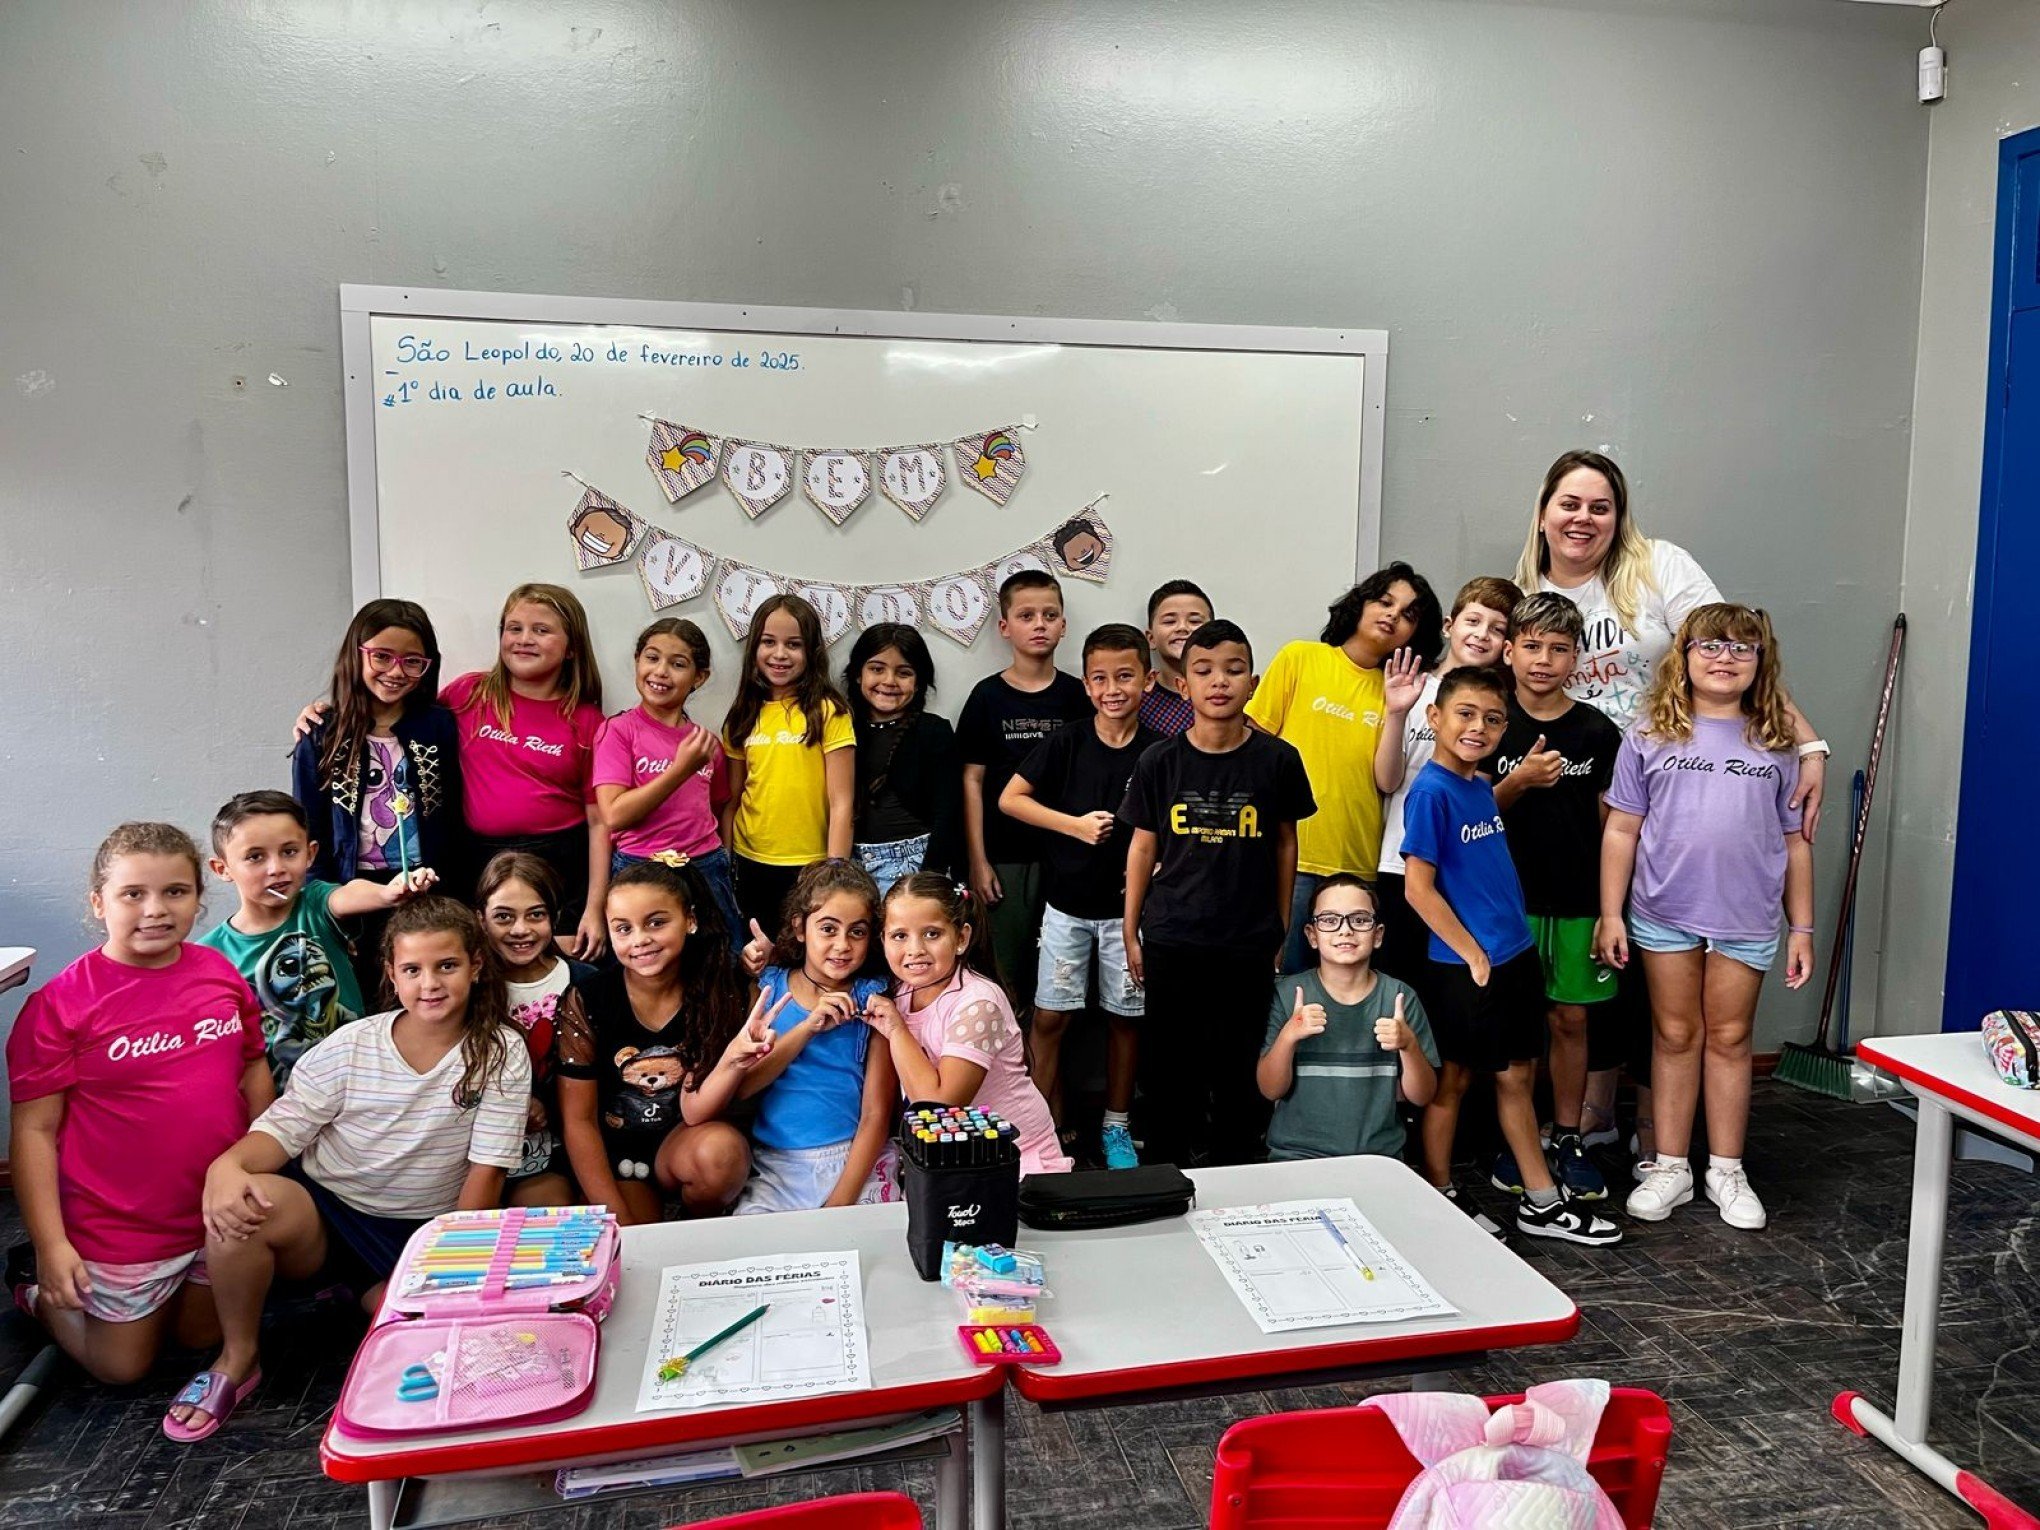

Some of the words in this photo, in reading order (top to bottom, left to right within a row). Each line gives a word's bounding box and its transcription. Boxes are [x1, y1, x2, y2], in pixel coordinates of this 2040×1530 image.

[396, 335, 450, 363] São
[570, 342, 594, 362] 20
[606, 341, 628, 362] de
[640, 343, 723, 366] fevereiro
[731, 350, 750, 368] de
[429, 381, 462, 401] dia
[474, 379, 496, 399] de
[747, 451, 925, 498] BEM
[1312, 696, 1355, 721] Otilia
[523, 735, 564, 757] Rieth
[1663, 755, 1715, 772] Otilia
[1723, 759, 1774, 779] Rieth
[1461, 821, 1494, 844] Otilia
[108, 1031, 186, 1061] Otilia
[746, 1274, 772, 1284] DAS
